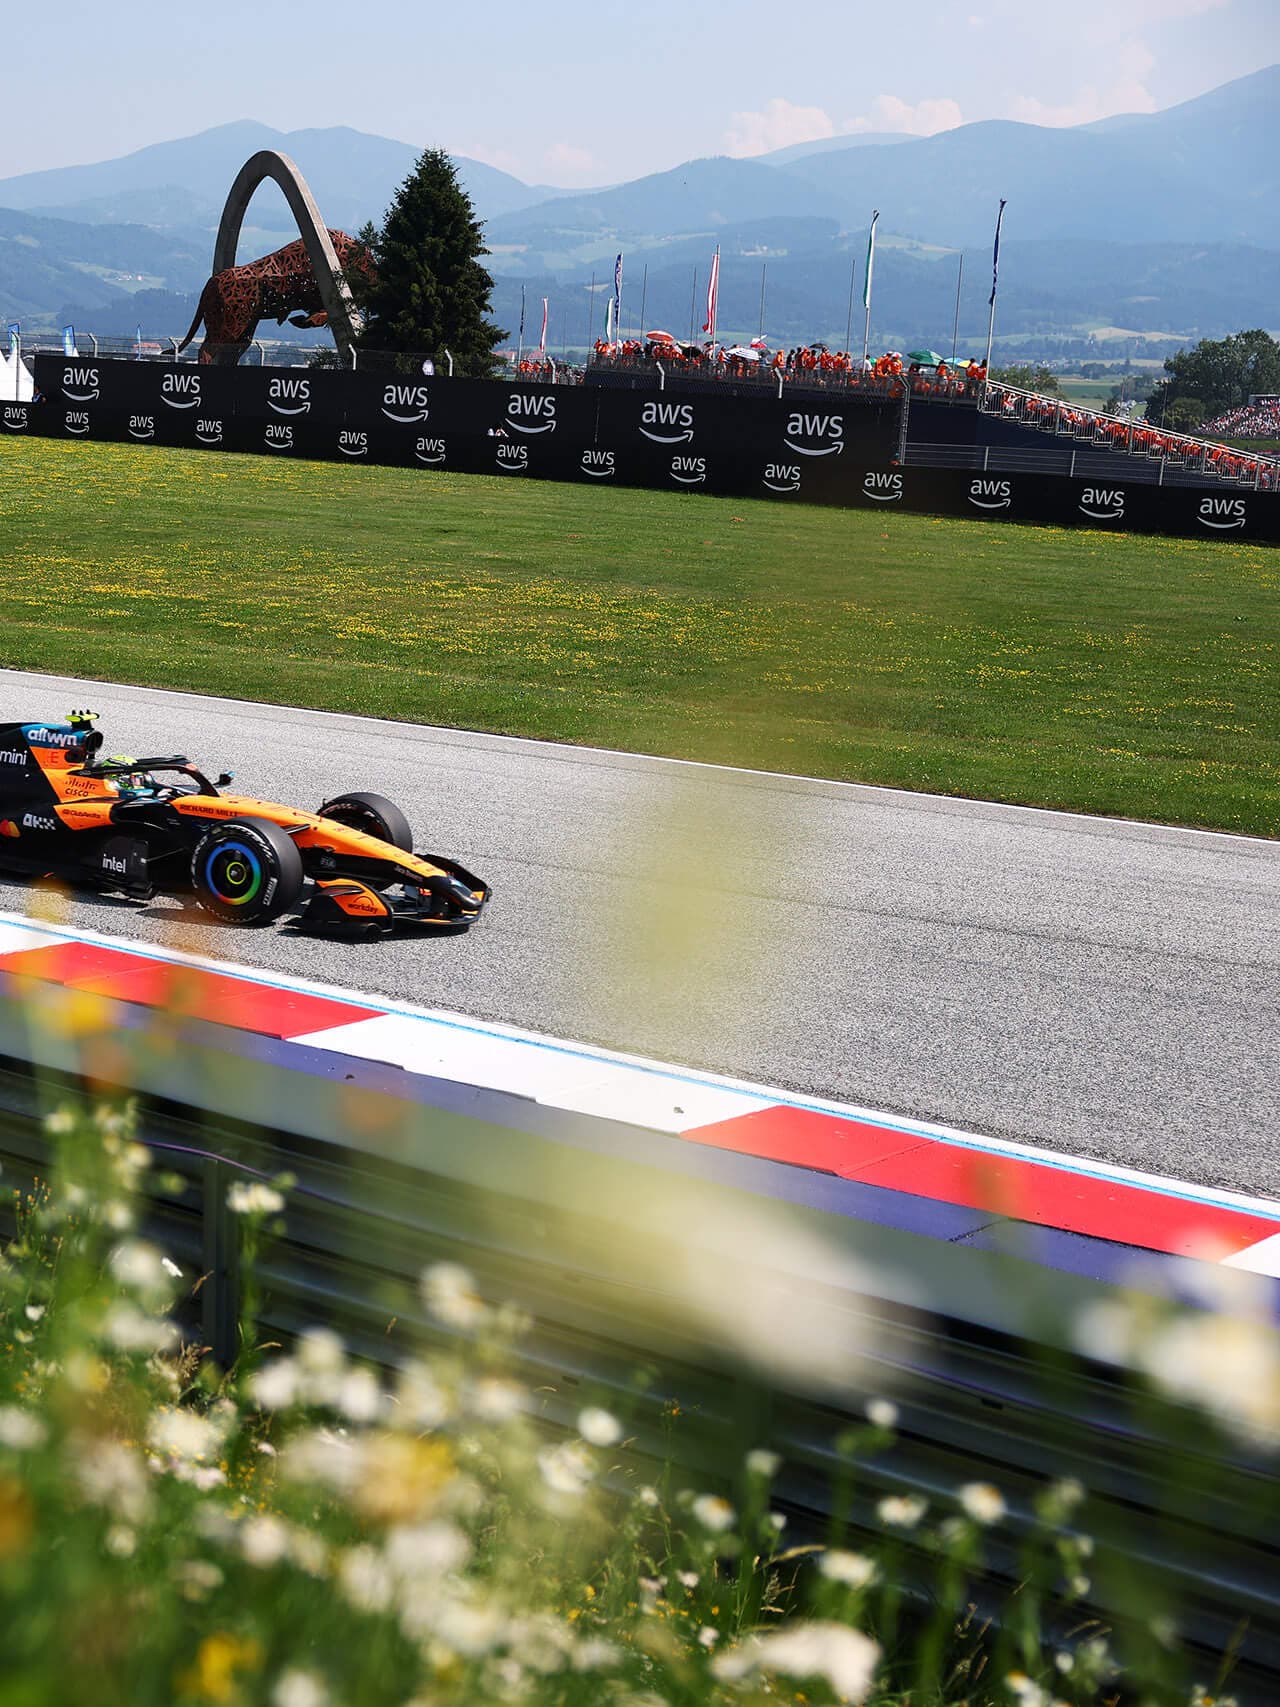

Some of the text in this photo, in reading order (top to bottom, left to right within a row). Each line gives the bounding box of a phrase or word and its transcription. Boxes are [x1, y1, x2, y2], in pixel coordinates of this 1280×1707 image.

[64, 368, 98, 386] aws
[163, 374, 200, 393] aws
[270, 379, 309, 399] aws
[384, 385, 427, 406] aws
[508, 395, 555, 416] aws
[66, 412, 88, 424] aws
[130, 416, 153, 428] aws
[643, 403, 693, 426] aws
[197, 420, 222, 433] aws
[266, 425, 292, 438] aws
[787, 414, 842, 437] aws
[340, 431, 367, 445] aws
[417, 438, 445, 452] aws
[498, 445, 527, 459] aws
[583, 451, 614, 465] aws
[672, 457, 705, 471] aws
[765, 464, 800, 480] aws
[865, 473, 902, 488] aws
[971, 480, 1010, 496] aws
[1082, 489, 1124, 506] aws
[1200, 499, 1245, 515] aws
[27, 727, 77, 747] allwyn
[102, 853, 126, 873] intel
